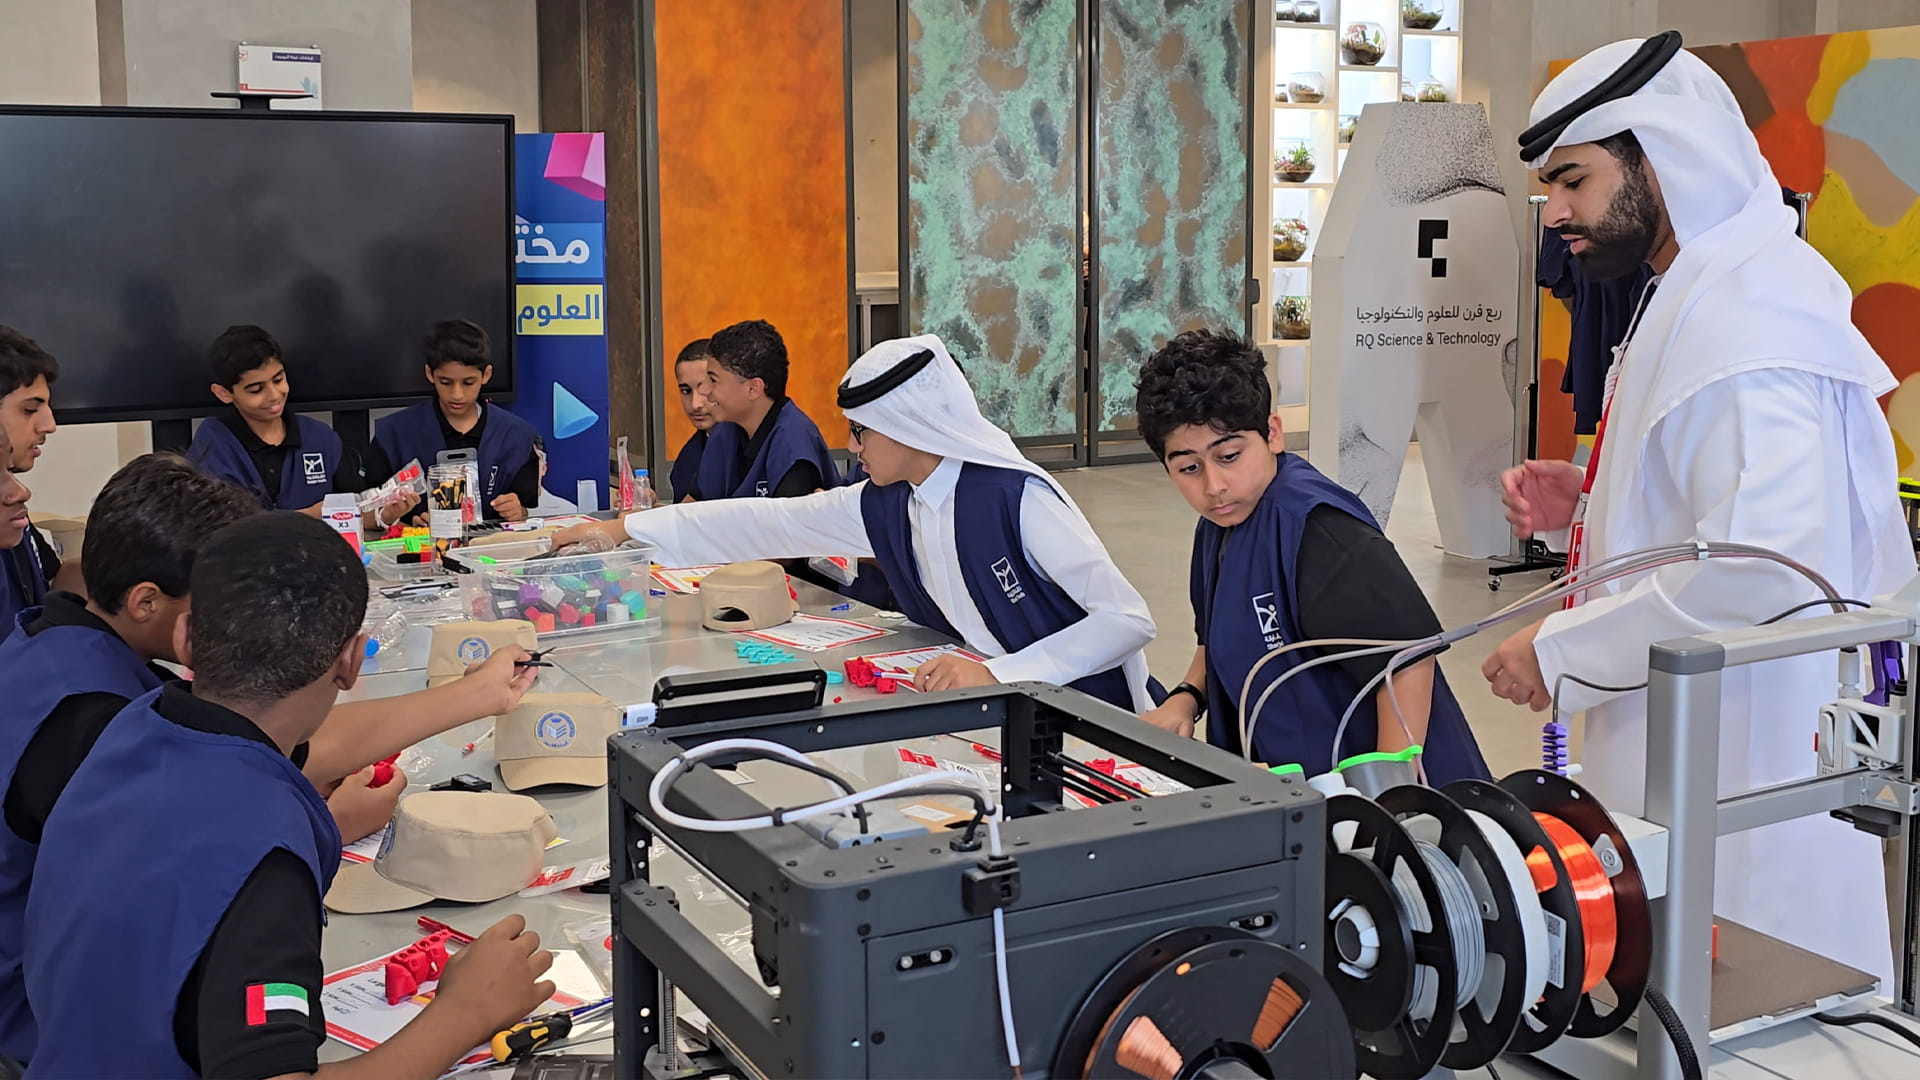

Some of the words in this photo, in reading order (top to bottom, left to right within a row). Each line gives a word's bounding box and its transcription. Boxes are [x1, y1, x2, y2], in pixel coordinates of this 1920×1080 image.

[518, 294, 600, 333] العلوم
[1356, 306, 1423, 323] والتكنولوجيا
[1427, 305, 1460, 323] للعلوم
[1463, 304, 1483, 321] قرن
[1486, 308, 1502, 322] ربع
[1356, 334, 1374, 349] RQ
[1377, 333, 1423, 346] Science
[1426, 332, 1434, 345] &
[1437, 331, 1501, 346] Technology
[338, 521, 350, 529] X3
